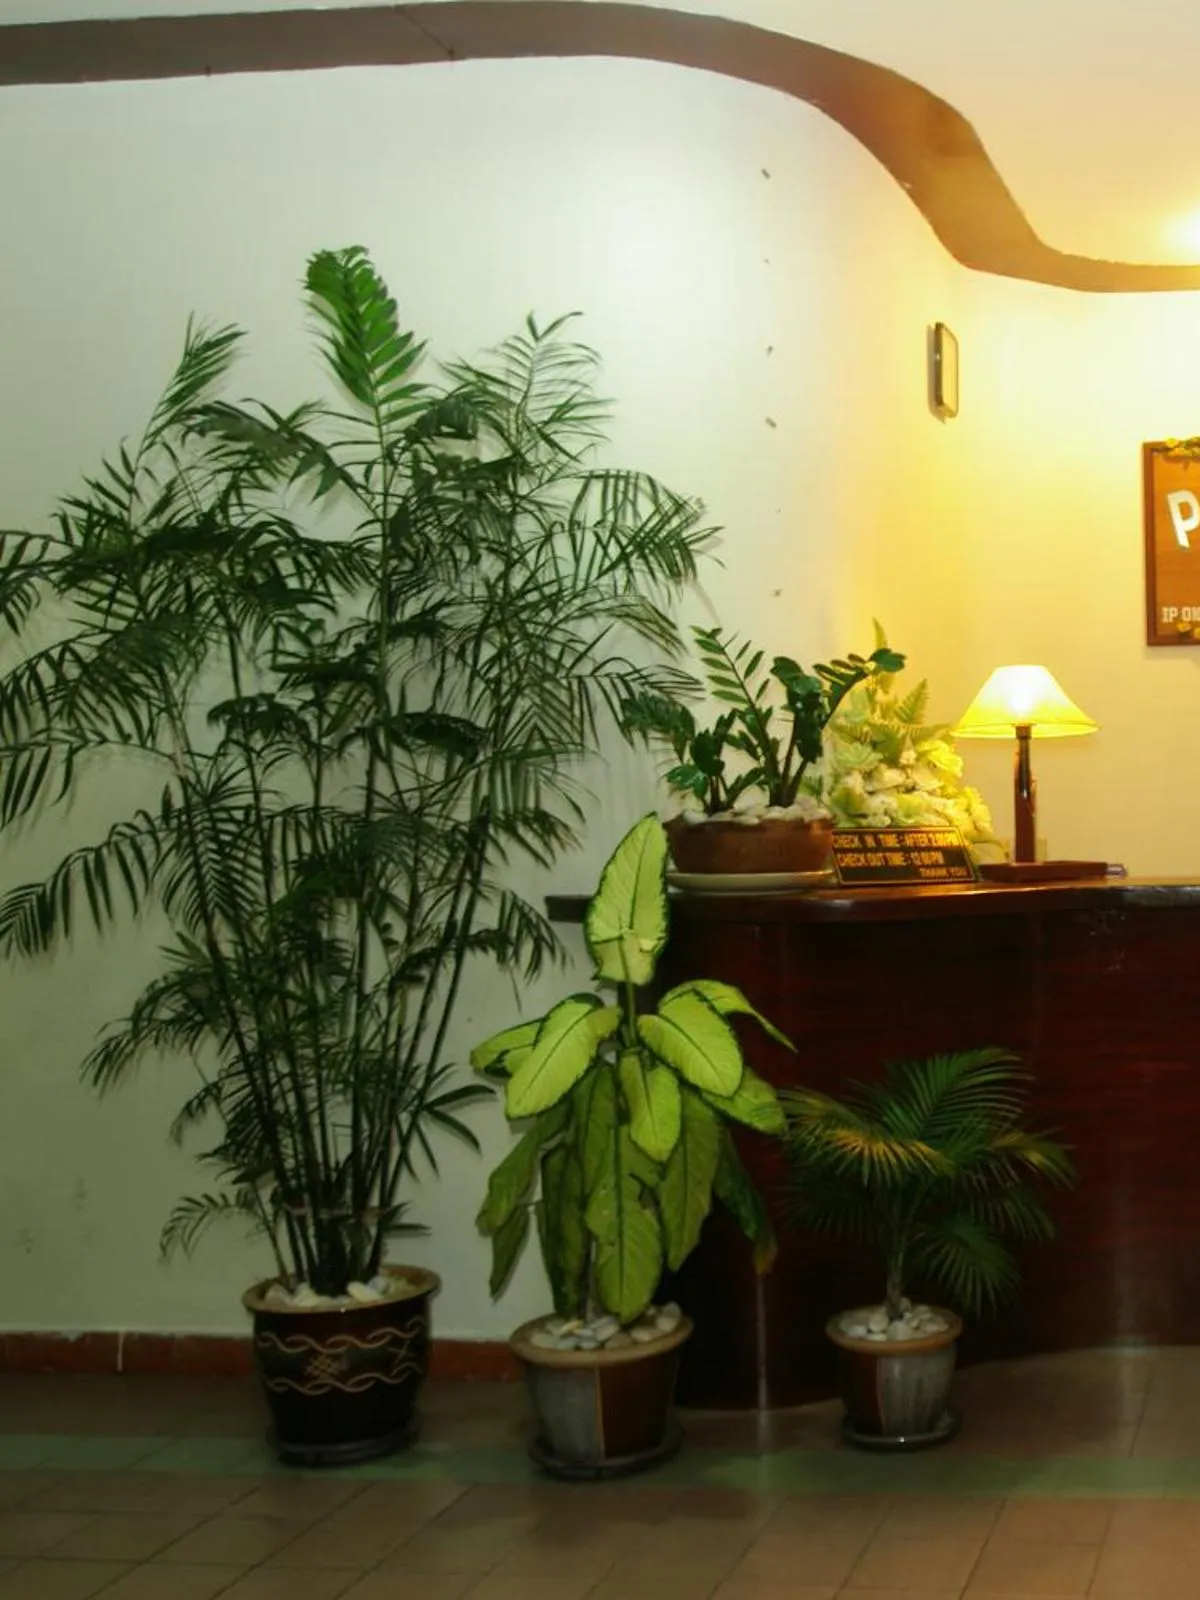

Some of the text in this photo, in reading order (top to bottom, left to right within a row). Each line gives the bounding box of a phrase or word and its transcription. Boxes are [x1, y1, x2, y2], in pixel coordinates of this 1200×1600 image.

[833, 833, 862, 848] CHECK
[836, 852, 866, 868] CHECK
[866, 851, 886, 867] OUT
